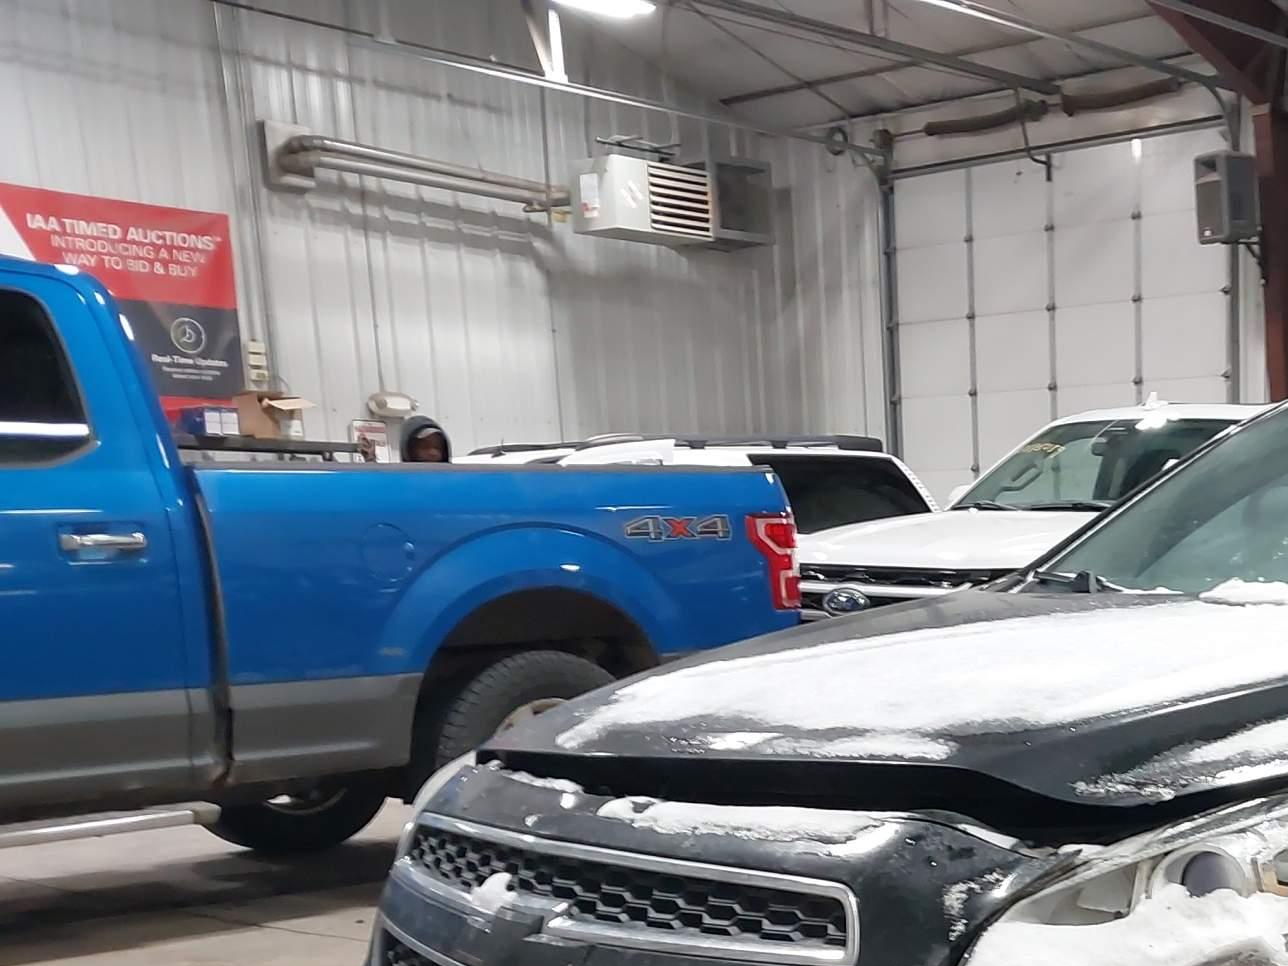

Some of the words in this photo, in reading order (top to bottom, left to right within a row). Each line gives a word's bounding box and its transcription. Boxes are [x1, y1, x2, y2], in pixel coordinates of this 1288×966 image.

[26, 213, 61, 232] IAA
[61, 218, 121, 240] TIMED
[50, 234, 154, 259] INTRODUCING
[158, 248, 173, 260] A
[172, 249, 206, 263] NEW
[63, 252, 97, 266] WAY
[100, 255, 122, 269] TO
[127, 259, 149, 273] BID
[153, 262, 166, 274] &
[168, 264, 198, 277] BUY
